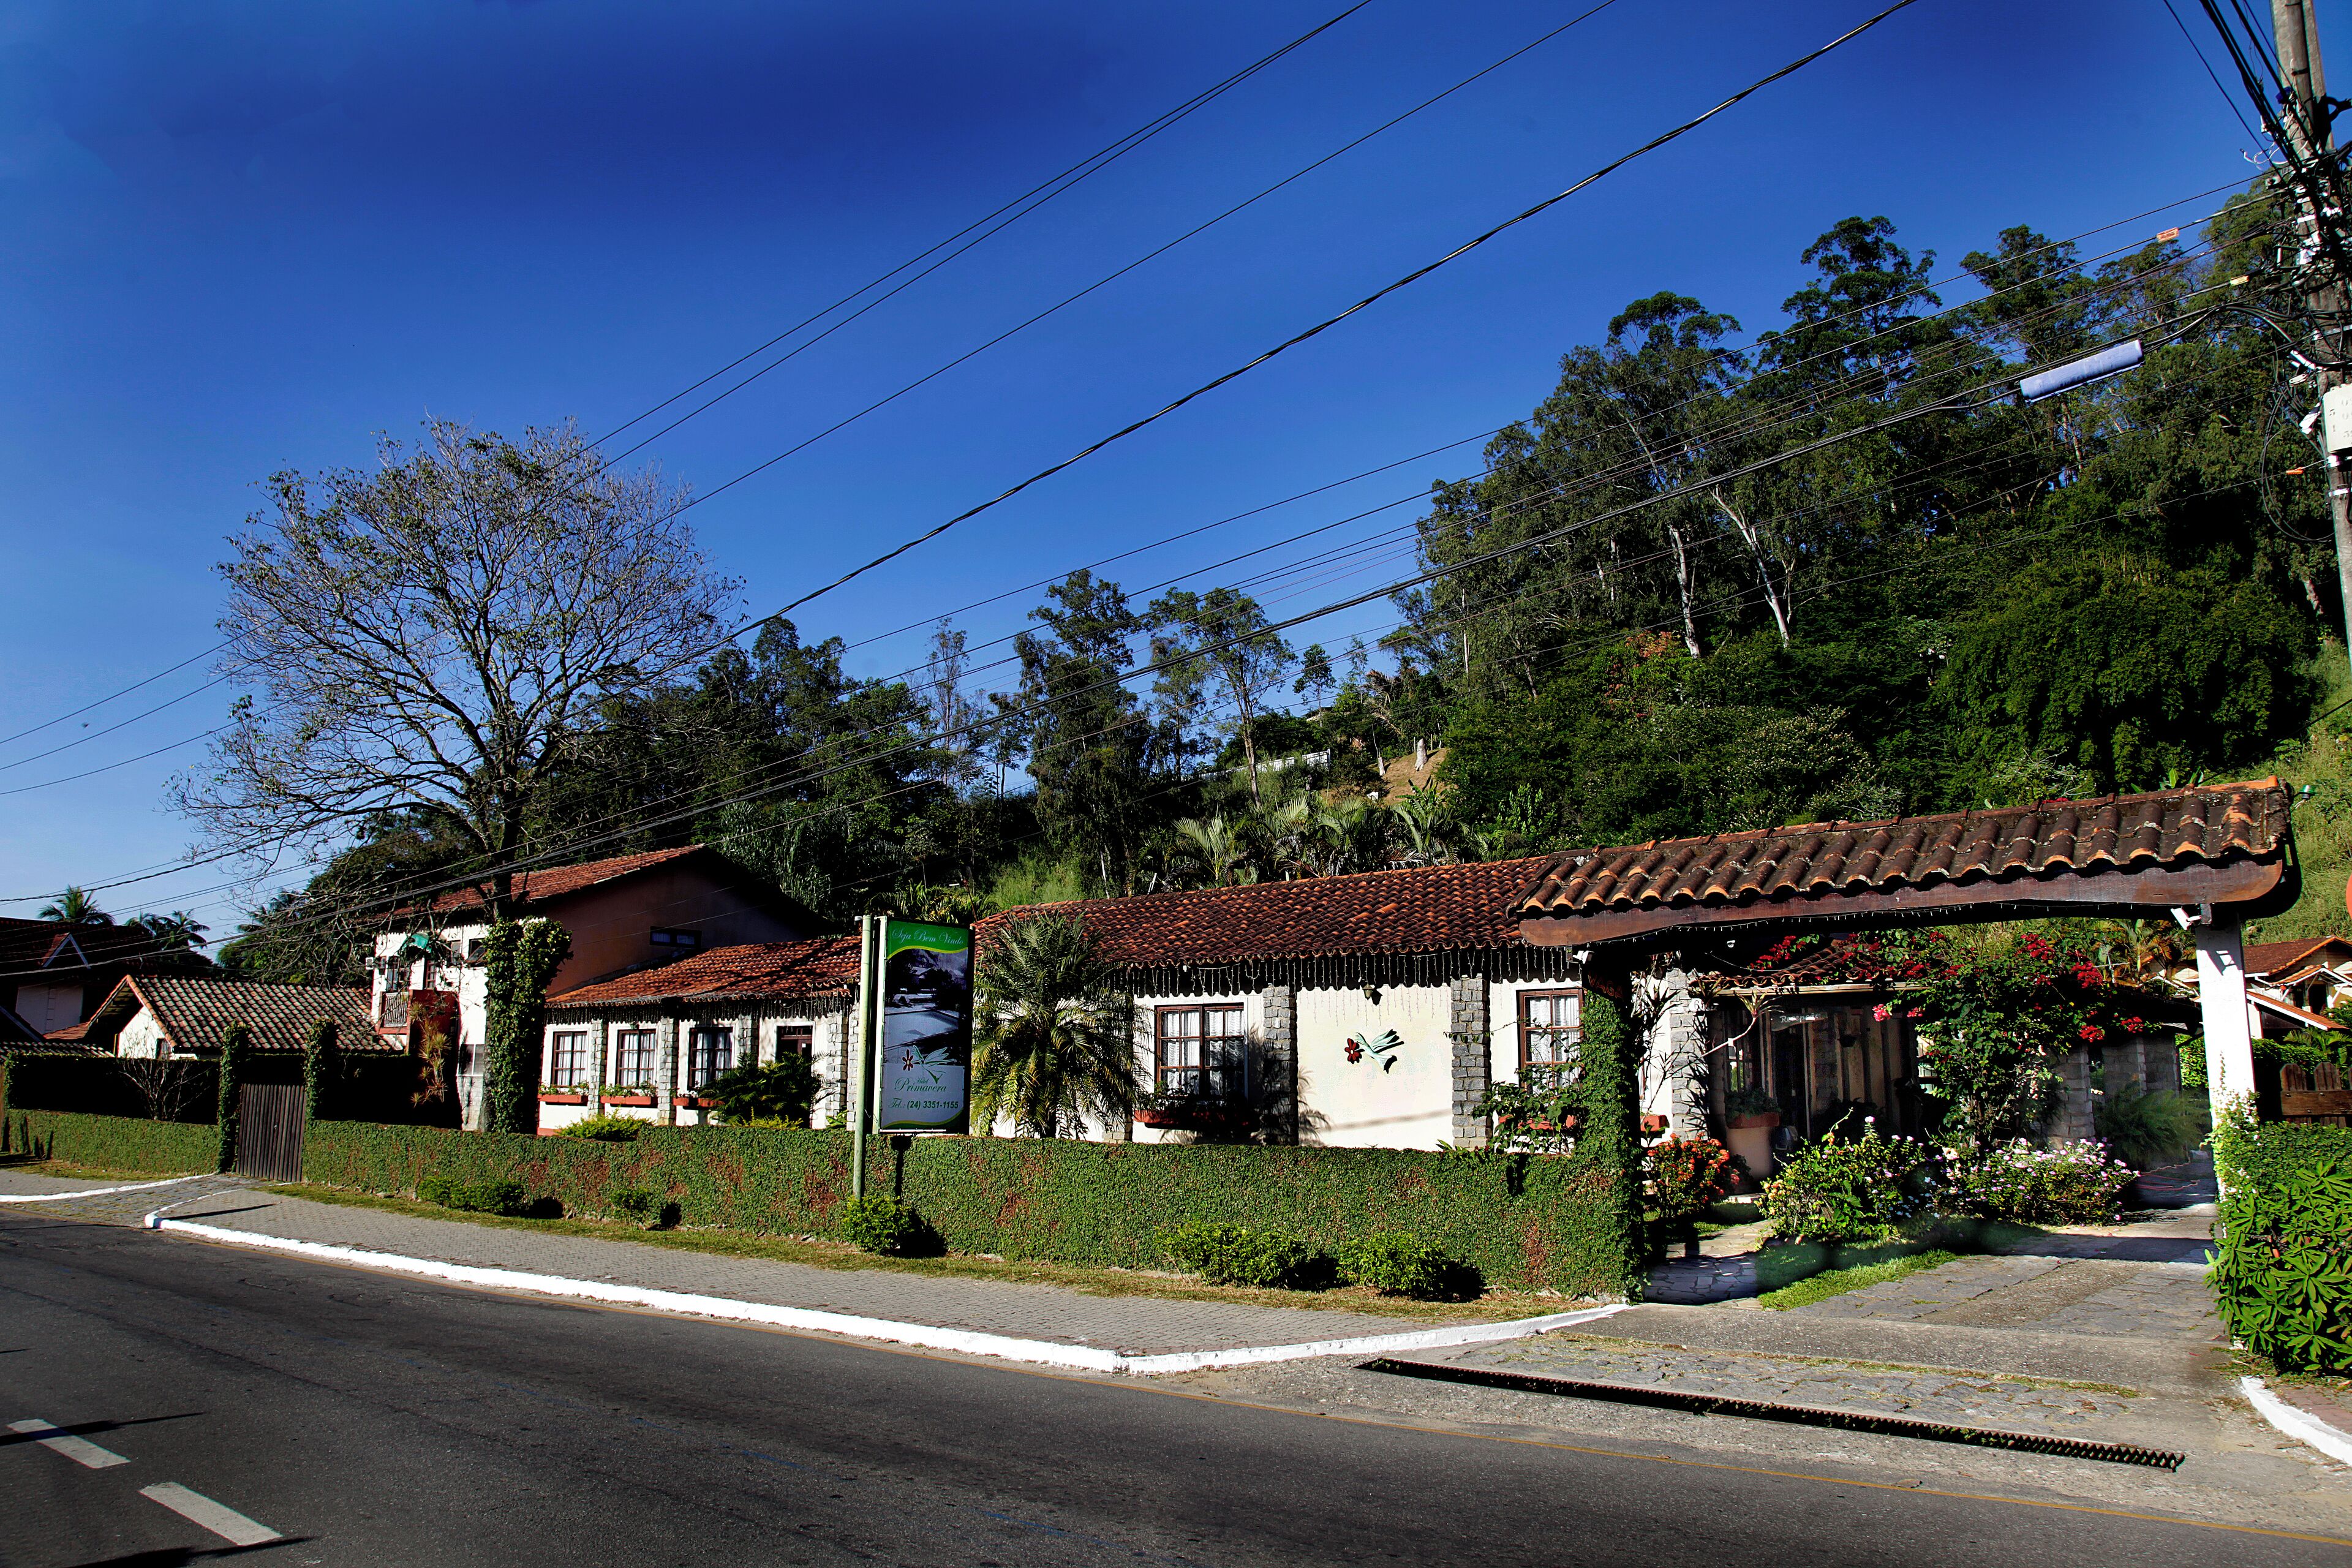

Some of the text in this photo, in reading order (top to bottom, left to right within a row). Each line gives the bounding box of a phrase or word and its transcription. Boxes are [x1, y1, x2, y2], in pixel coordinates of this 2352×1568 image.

[892, 929, 964, 945] Seja Bem Vindo
[894, 1077, 947, 1092] Primavera
[907, 1100, 921, 1110] (24)
[923, 1100, 959, 1109] 3351-1155
